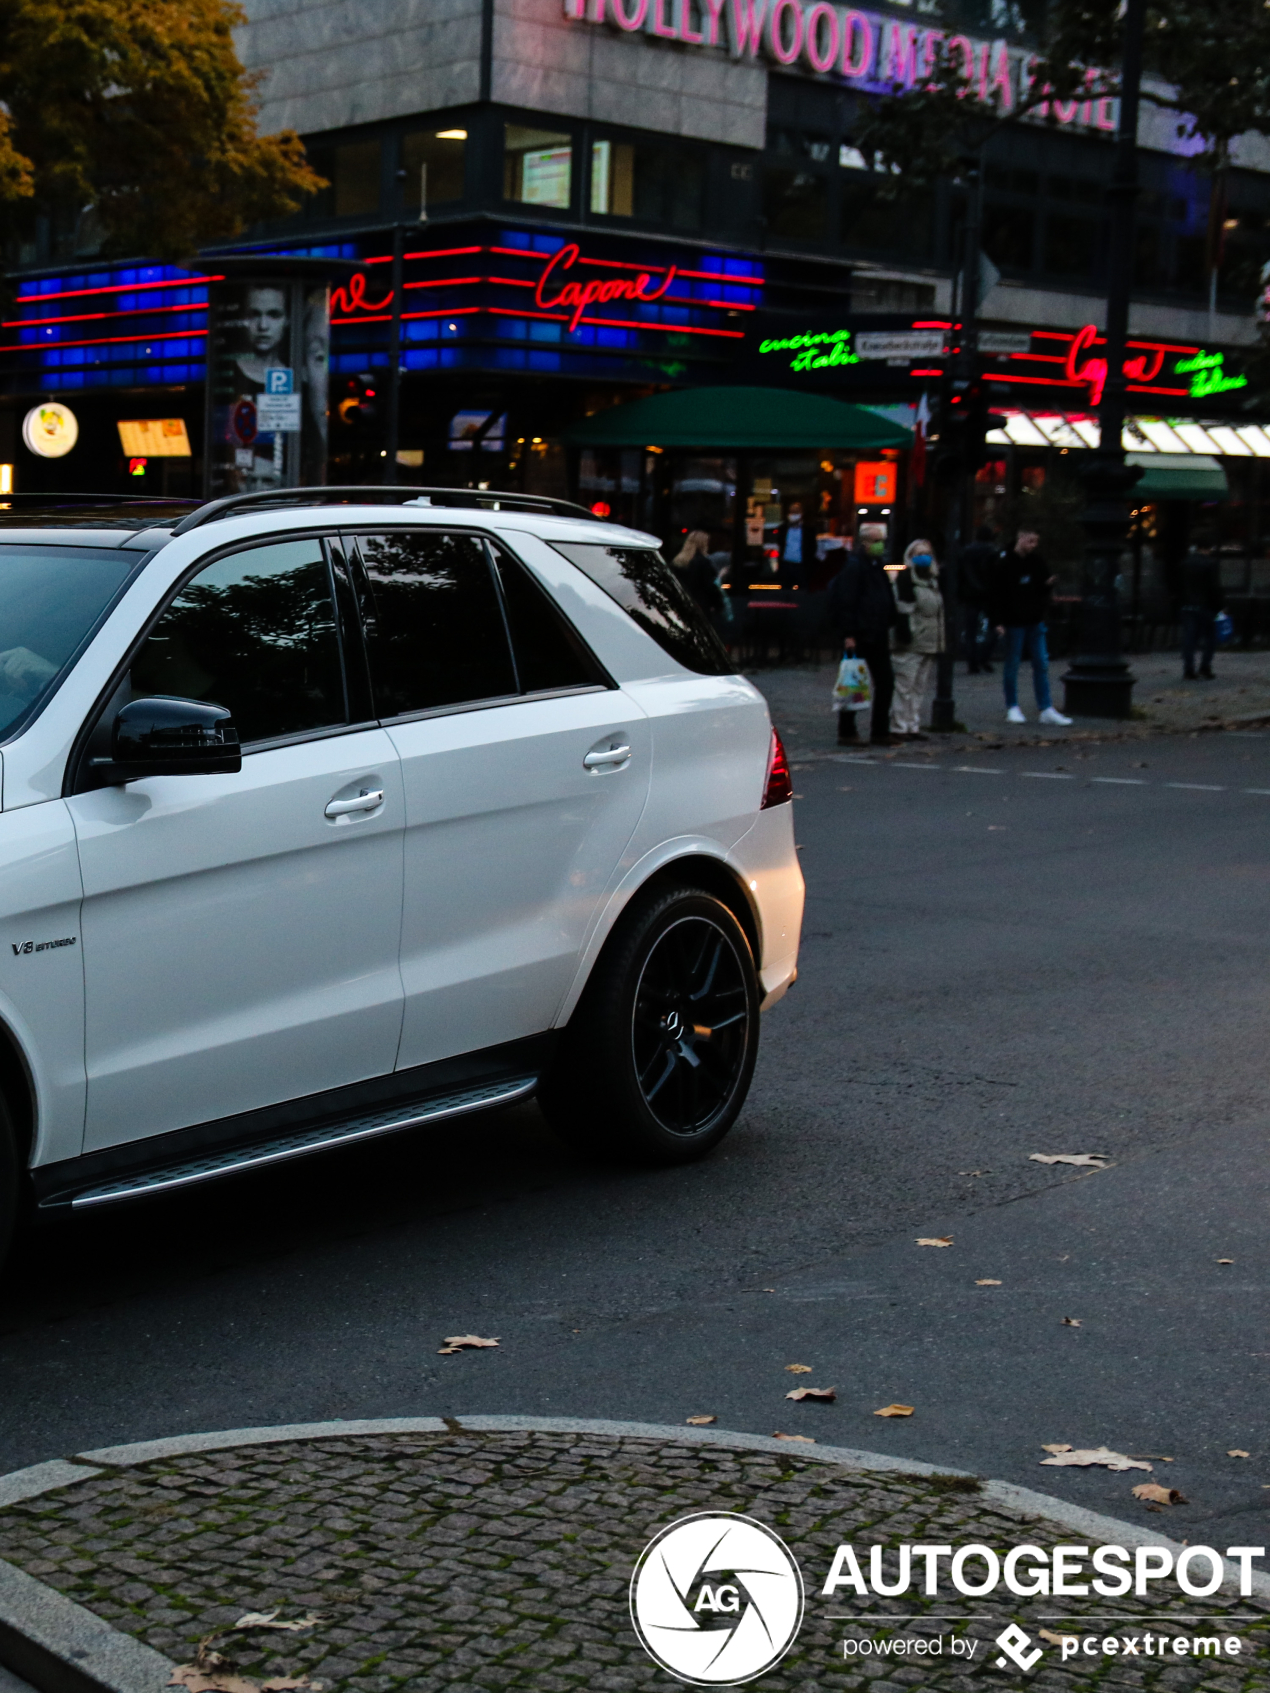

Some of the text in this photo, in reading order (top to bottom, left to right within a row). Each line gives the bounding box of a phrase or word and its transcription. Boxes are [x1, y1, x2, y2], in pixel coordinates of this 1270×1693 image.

[572, 0, 872, 78] OLLYWOOD
[535, 244, 676, 332] Capone
[1065, 324, 1165, 406] Capne
[12, 936, 76, 956] V8 BITURBO
